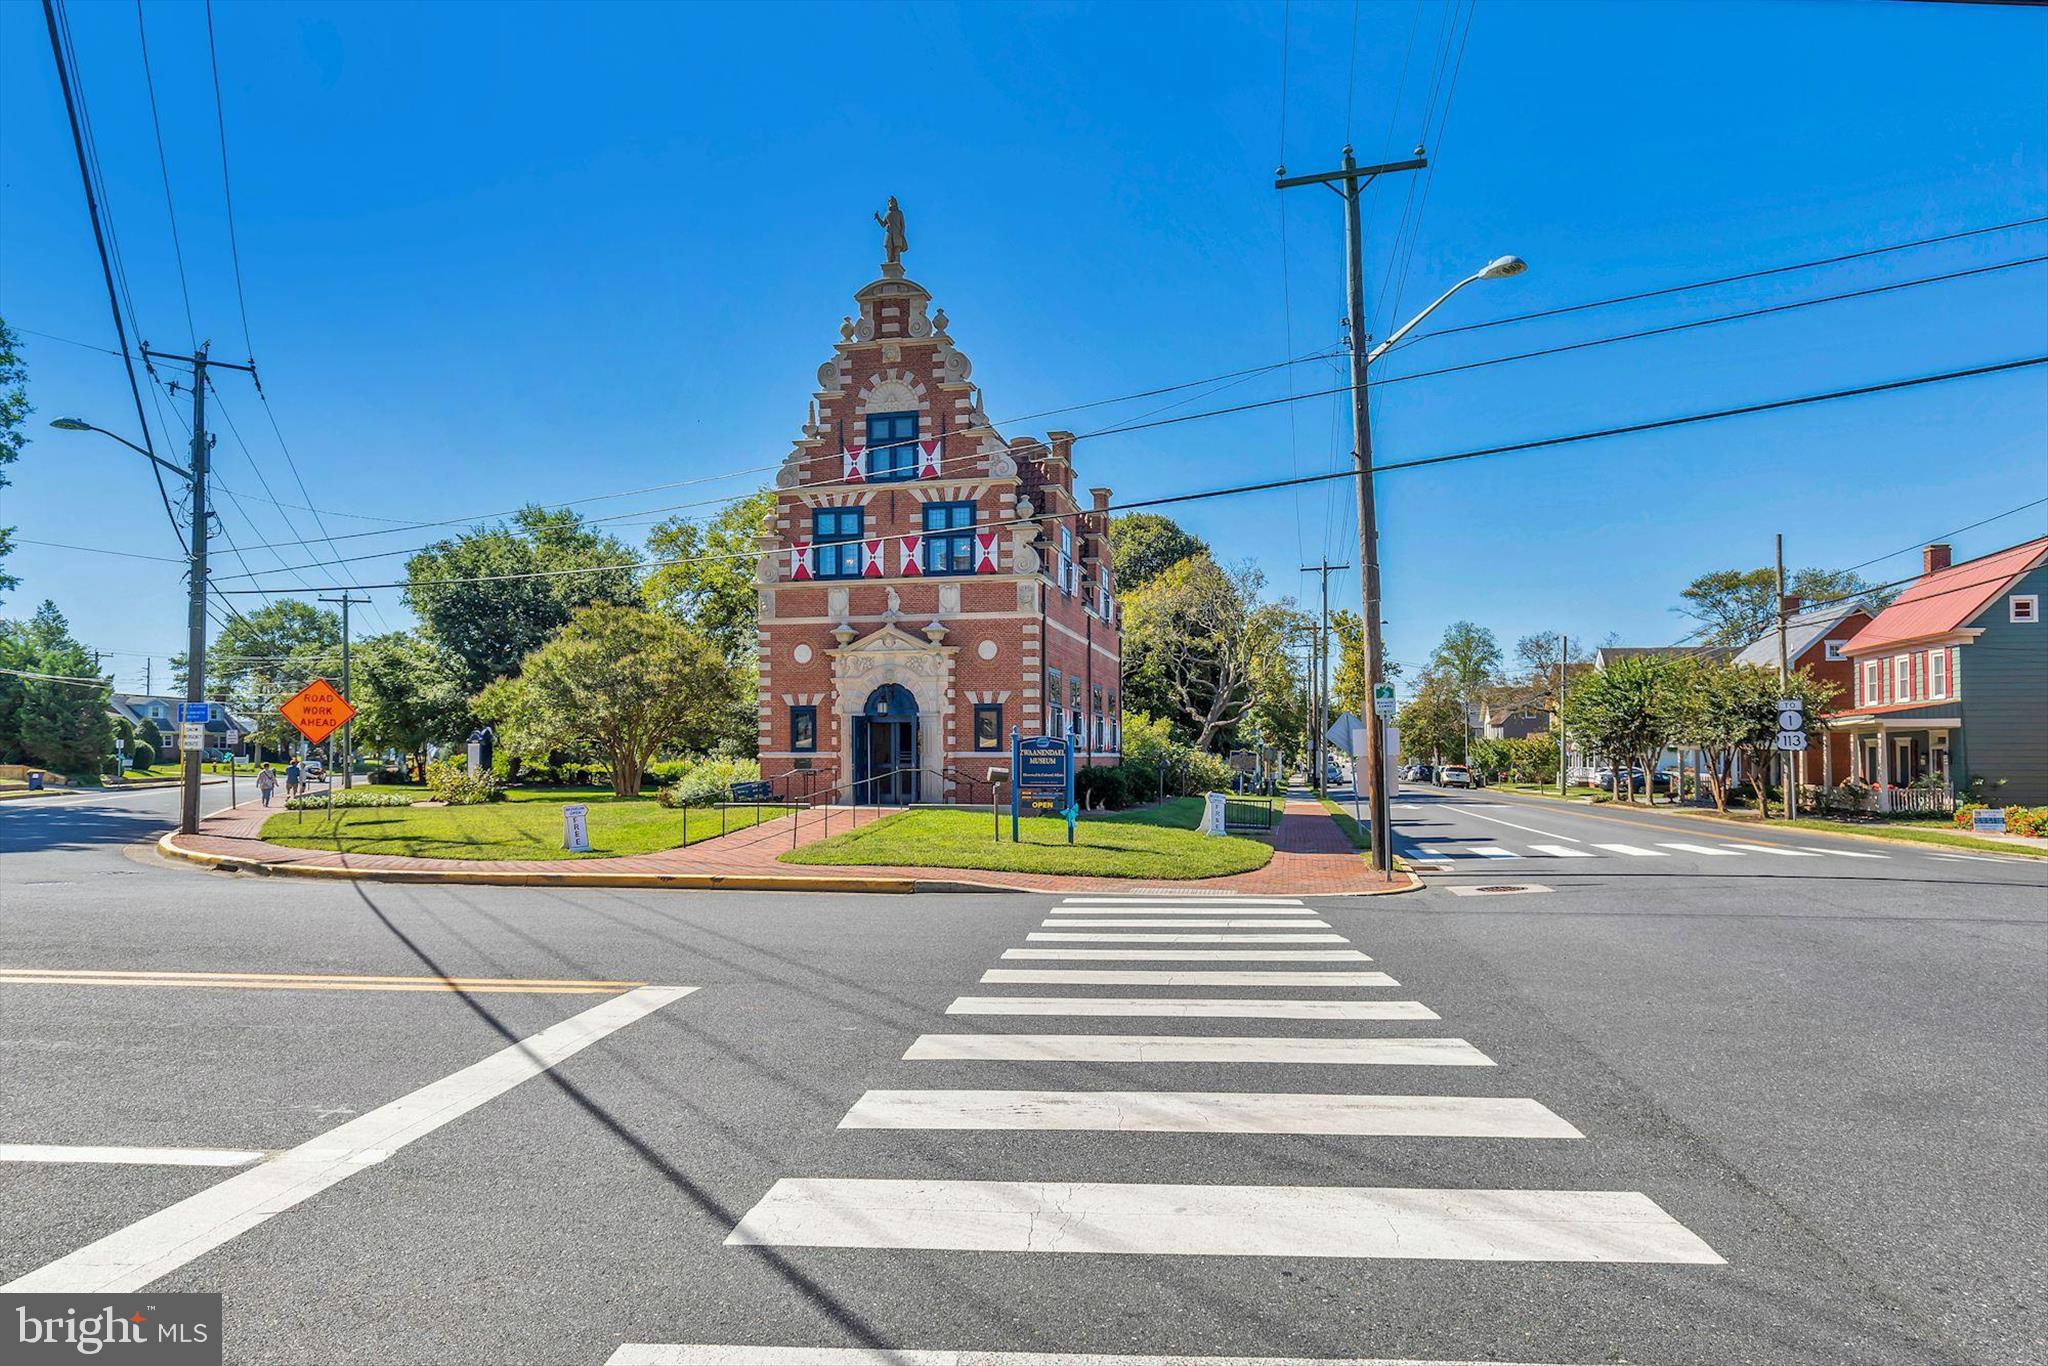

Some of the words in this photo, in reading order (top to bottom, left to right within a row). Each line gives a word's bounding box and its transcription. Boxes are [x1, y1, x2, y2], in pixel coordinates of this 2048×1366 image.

[303, 694, 333, 702] ROAD
[303, 706, 332, 715] WORK
[300, 719, 336, 727] AHEAD
[1783, 735, 1801, 746] 113
[572, 816, 581, 845] FREE
